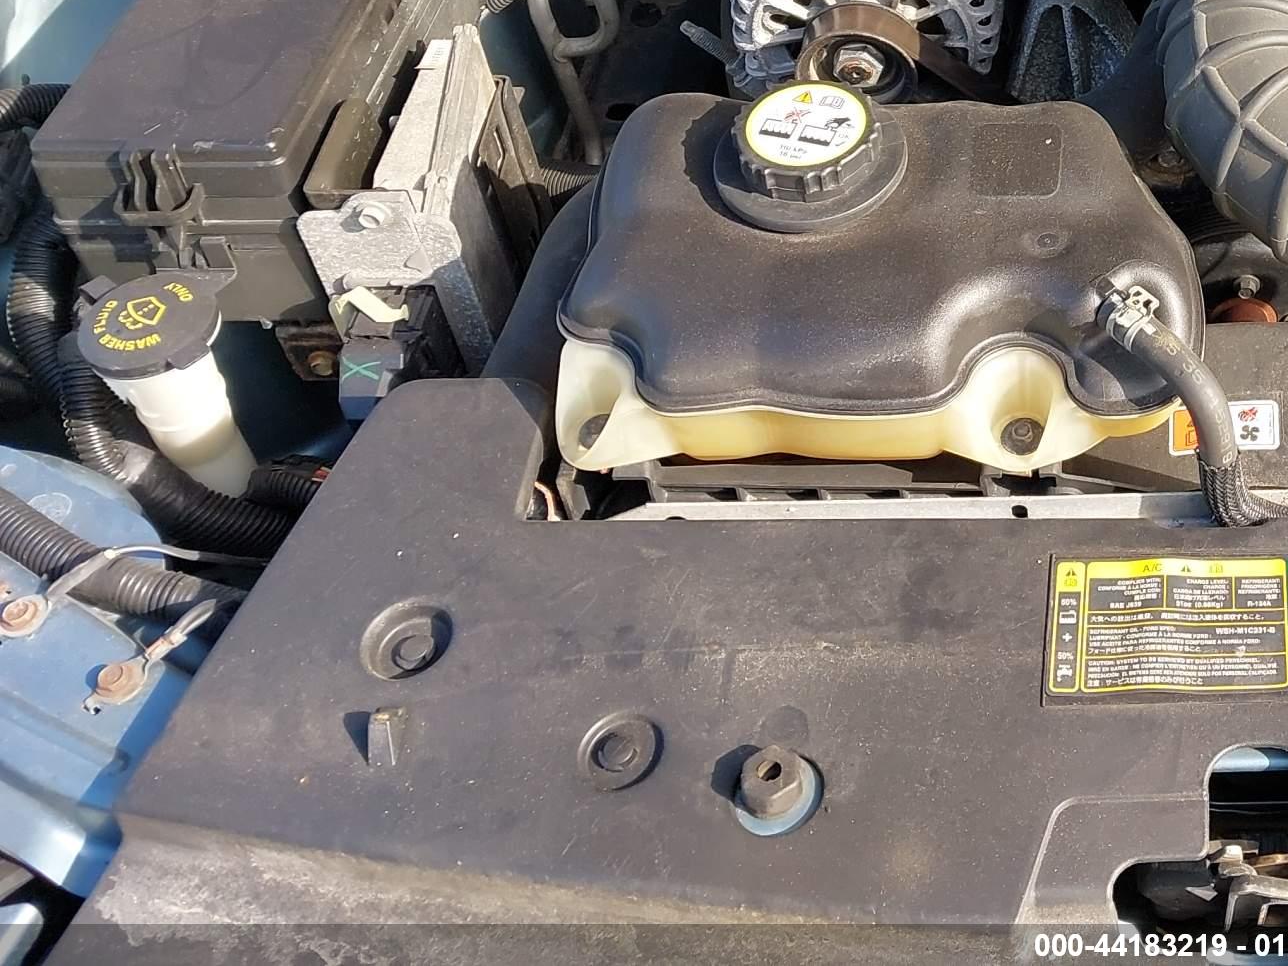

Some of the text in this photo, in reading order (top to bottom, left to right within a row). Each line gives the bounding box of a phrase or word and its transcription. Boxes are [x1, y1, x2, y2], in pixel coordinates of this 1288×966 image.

[163, 283, 193, 302] ONLY
[93, 300, 161, 351] WASHER FLUID
[1143, 563, 1162, 572] A/C
[1061, 598, 1077, 606] 50%
[1057, 652, 1074, 660] 50%
